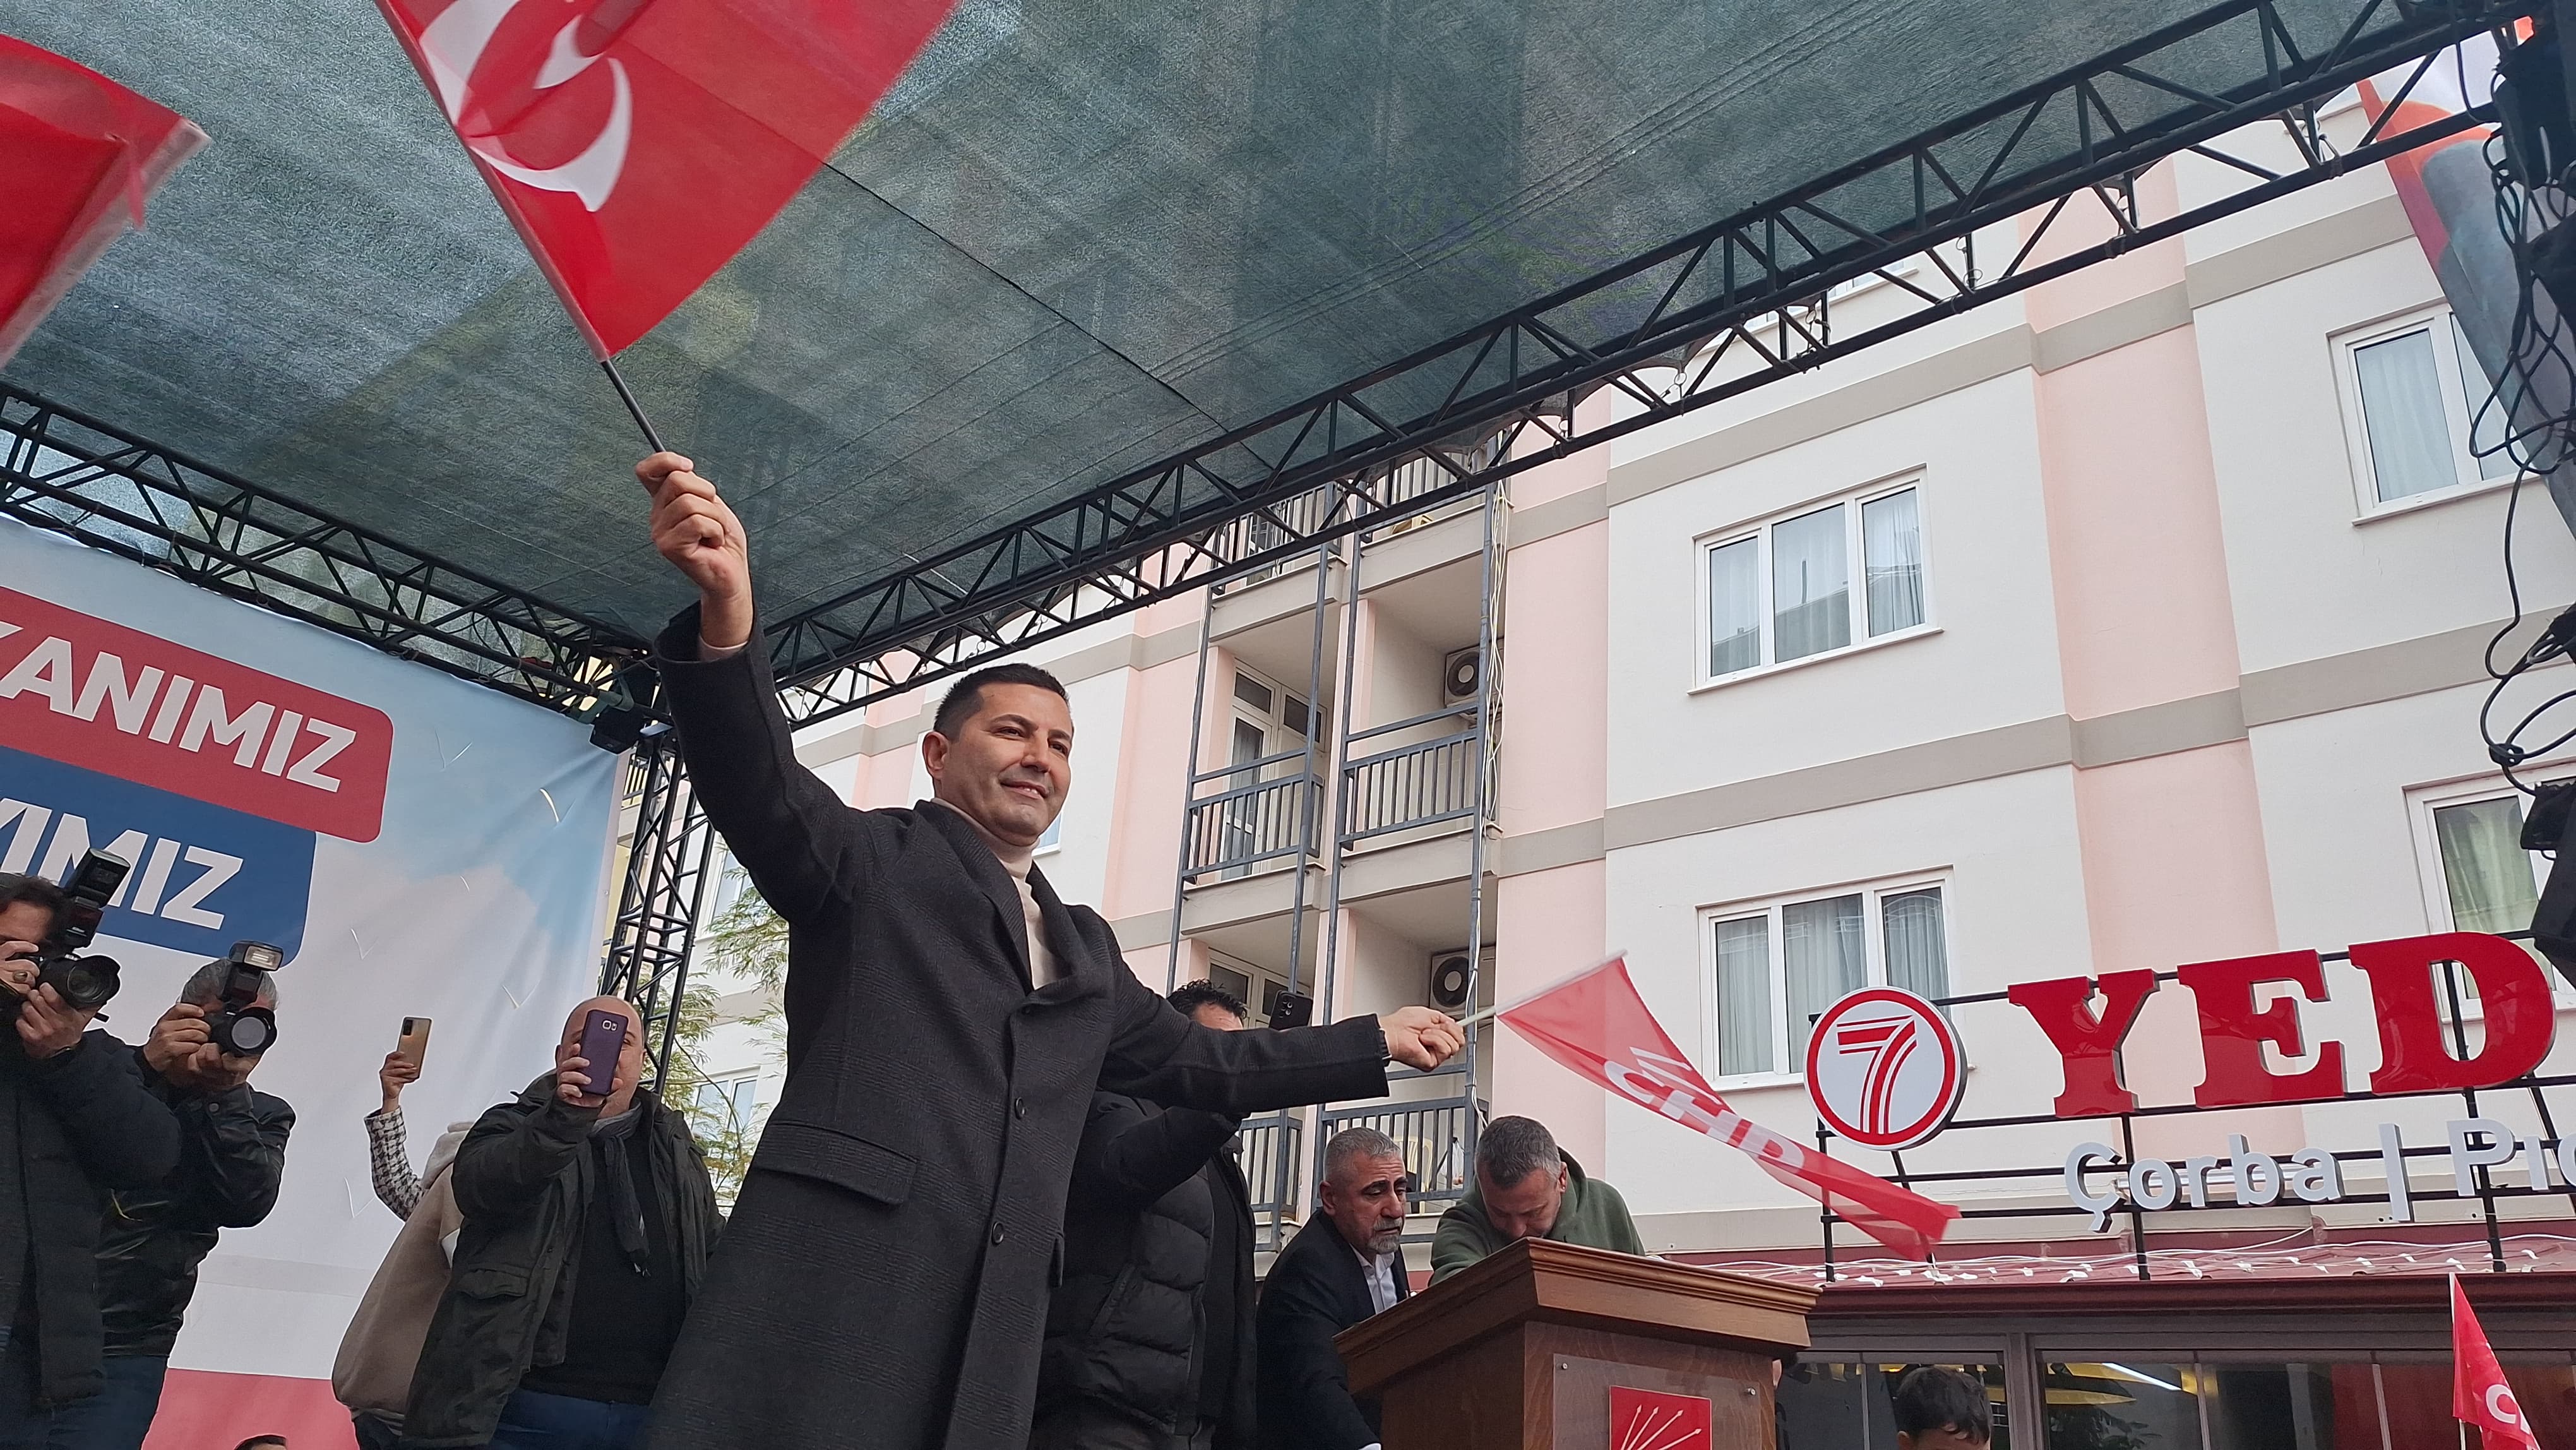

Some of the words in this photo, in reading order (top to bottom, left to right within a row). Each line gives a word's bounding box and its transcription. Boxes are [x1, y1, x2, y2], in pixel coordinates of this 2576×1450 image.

[0, 621, 356, 793] ANIMIZ
[1836, 1015, 1917, 1134] 7
[2007, 932, 2555, 1118] YED
[2065, 1133, 2342, 1233] Çorba
